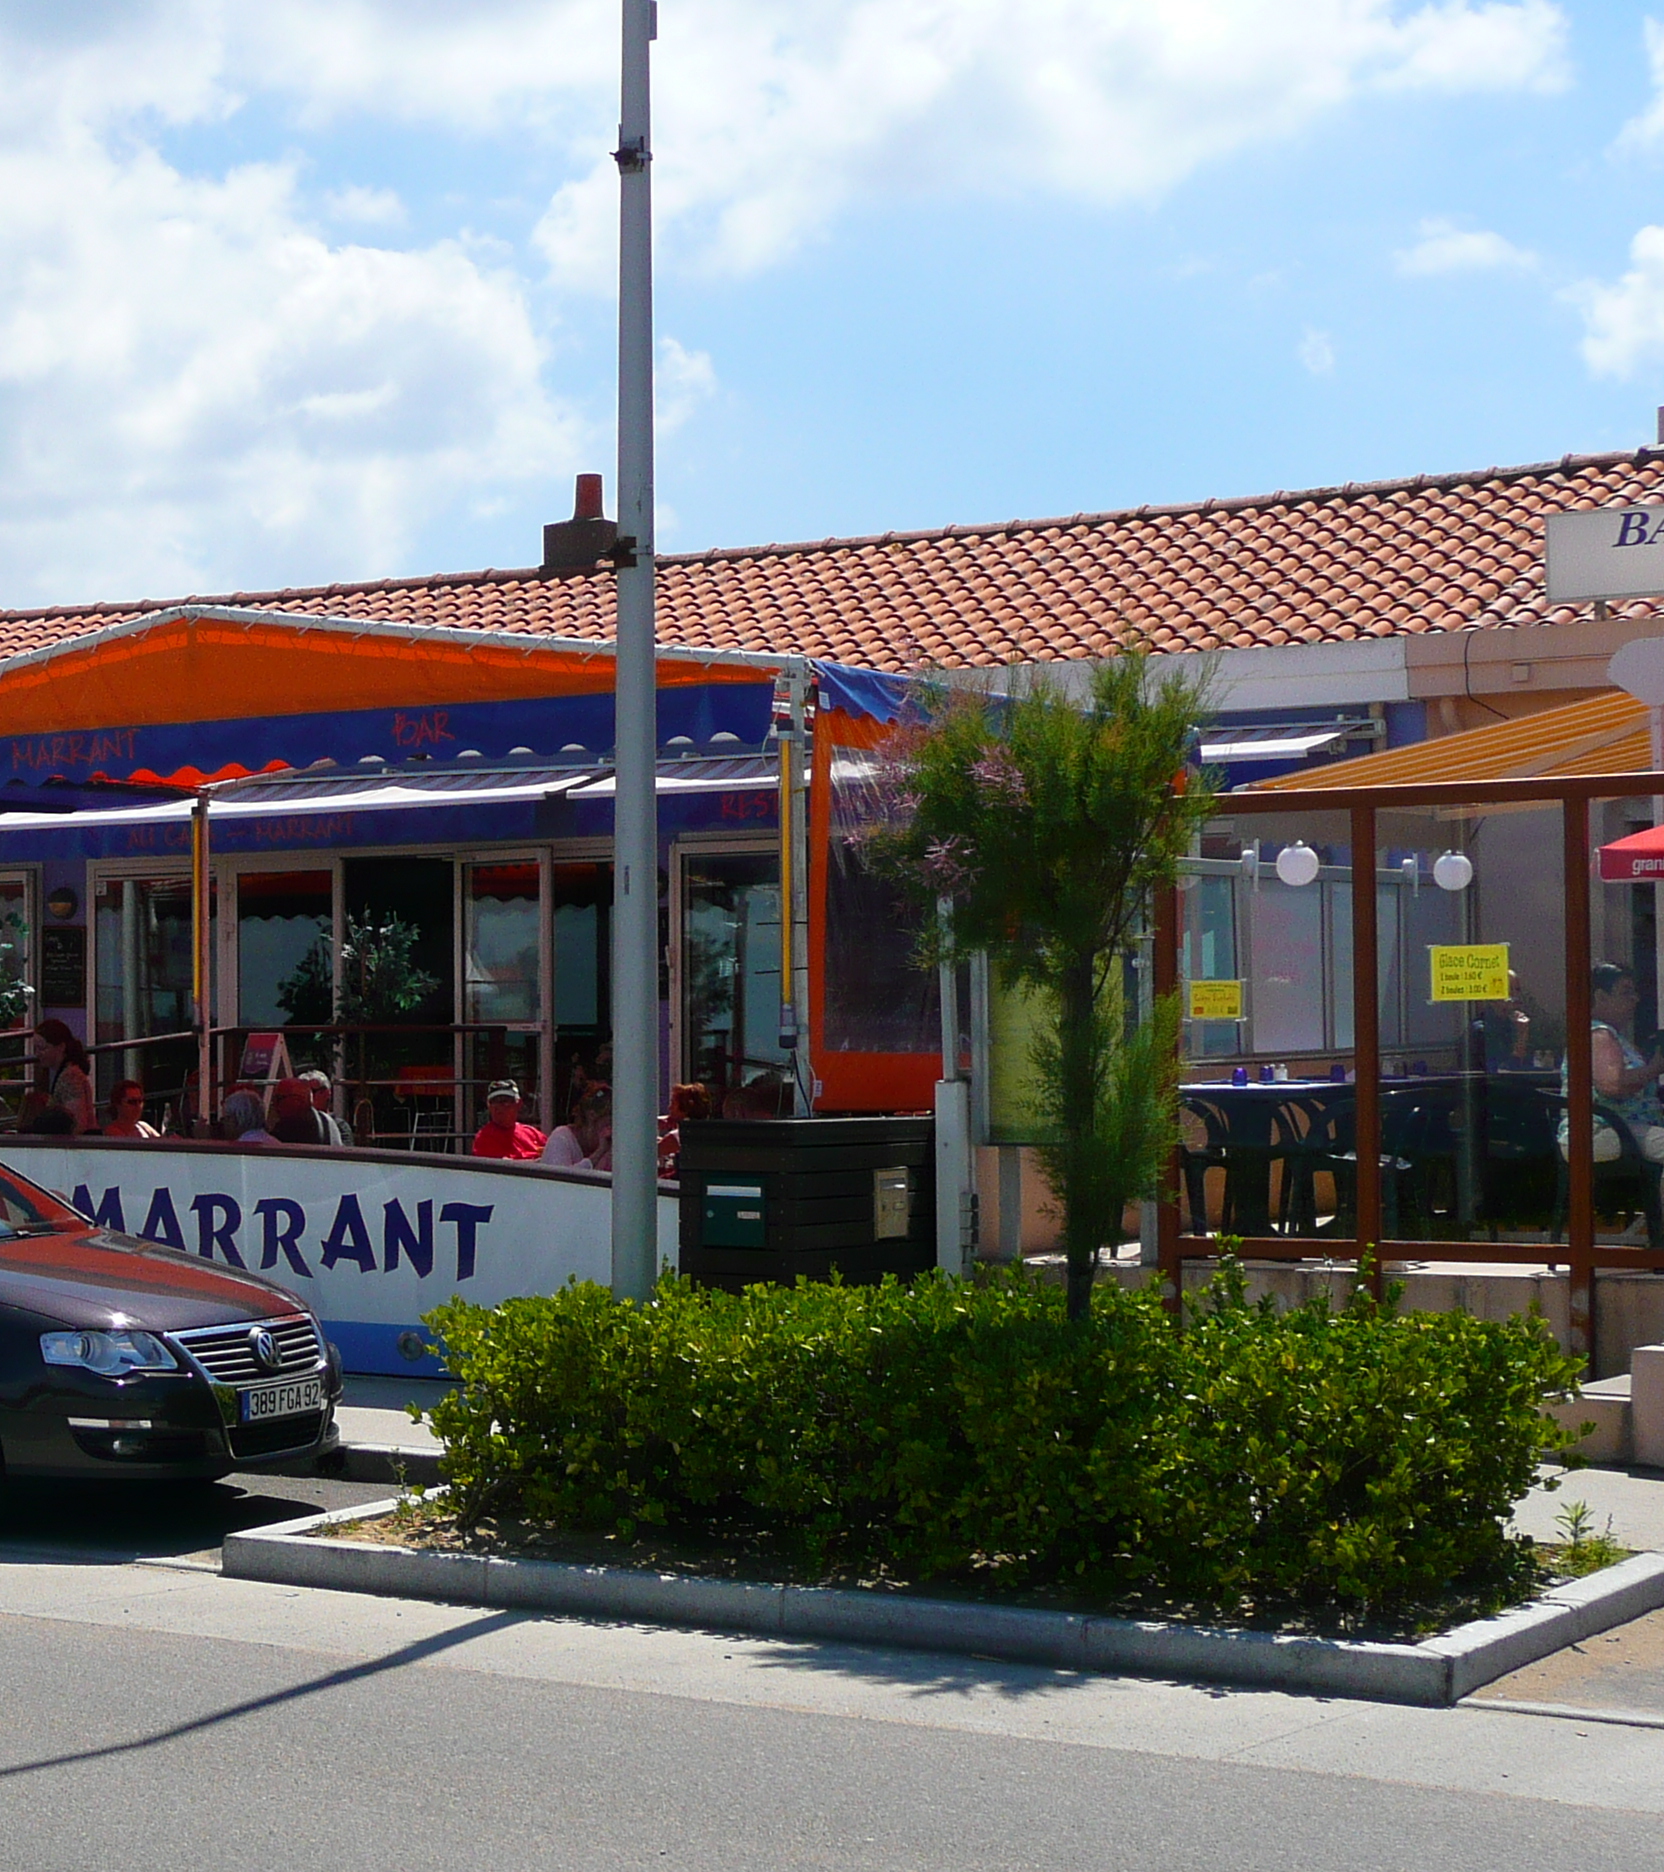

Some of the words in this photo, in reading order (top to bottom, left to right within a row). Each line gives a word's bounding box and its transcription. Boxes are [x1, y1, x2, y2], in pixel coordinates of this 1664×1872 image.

[391, 711, 455, 747] BAR
[12, 729, 140, 771] MARRANT
[73, 1183, 495, 1282] MARRANT
[250, 1390, 276, 1417] 389
[279, 1385, 302, 1412] FGA
[304, 1383, 319, 1407] 92
